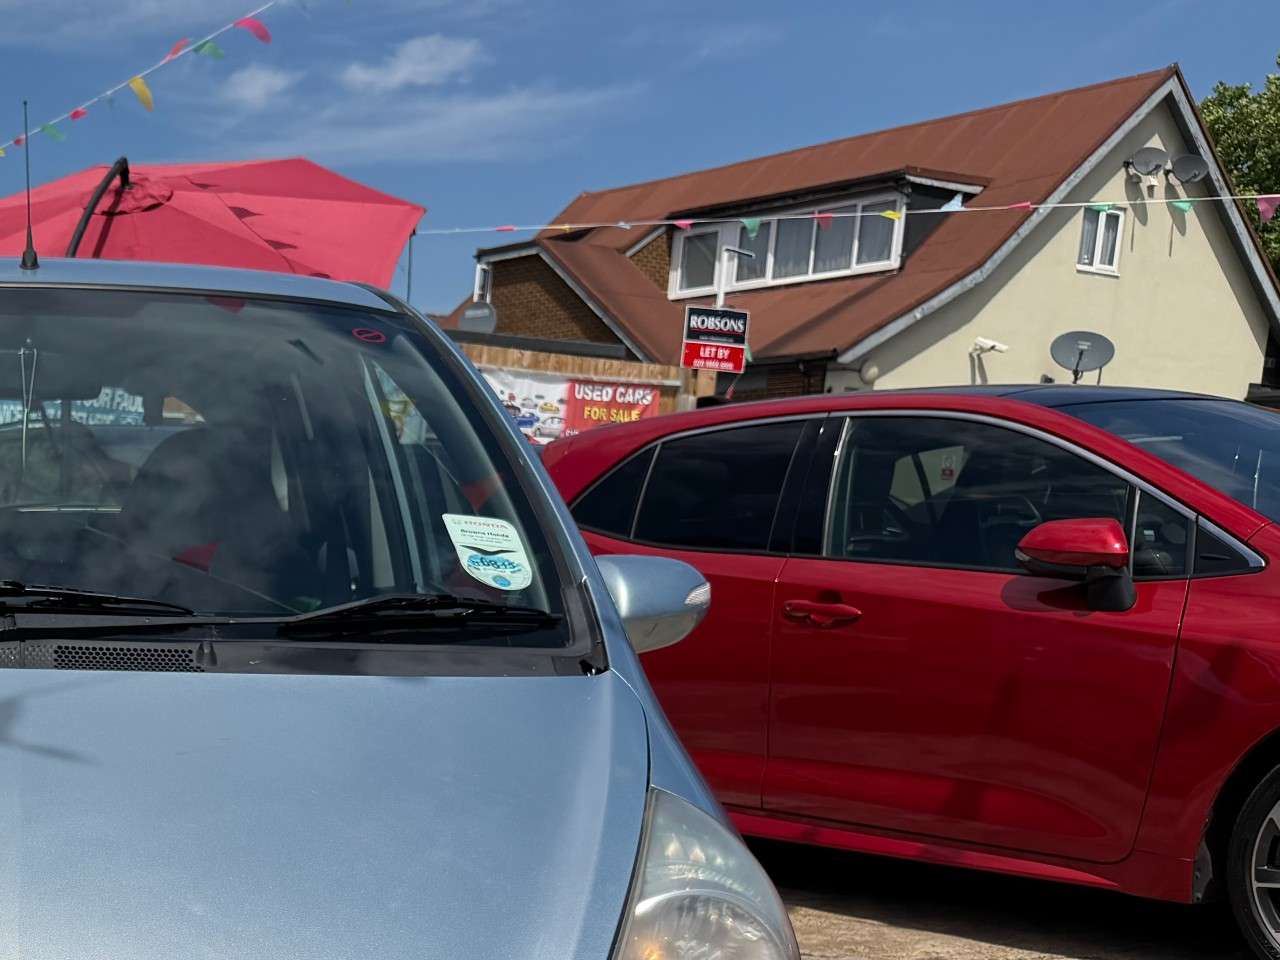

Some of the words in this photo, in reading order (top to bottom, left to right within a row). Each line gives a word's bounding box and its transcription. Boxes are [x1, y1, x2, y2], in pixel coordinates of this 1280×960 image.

[690, 315, 744, 332] ROBSONS
[700, 345, 717, 358] LET
[717, 347, 730, 359] BY
[574, 384, 612, 401] USED
[616, 386, 653, 405] CARS
[584, 406, 607, 420] FOR
[610, 408, 640, 422] SALE
